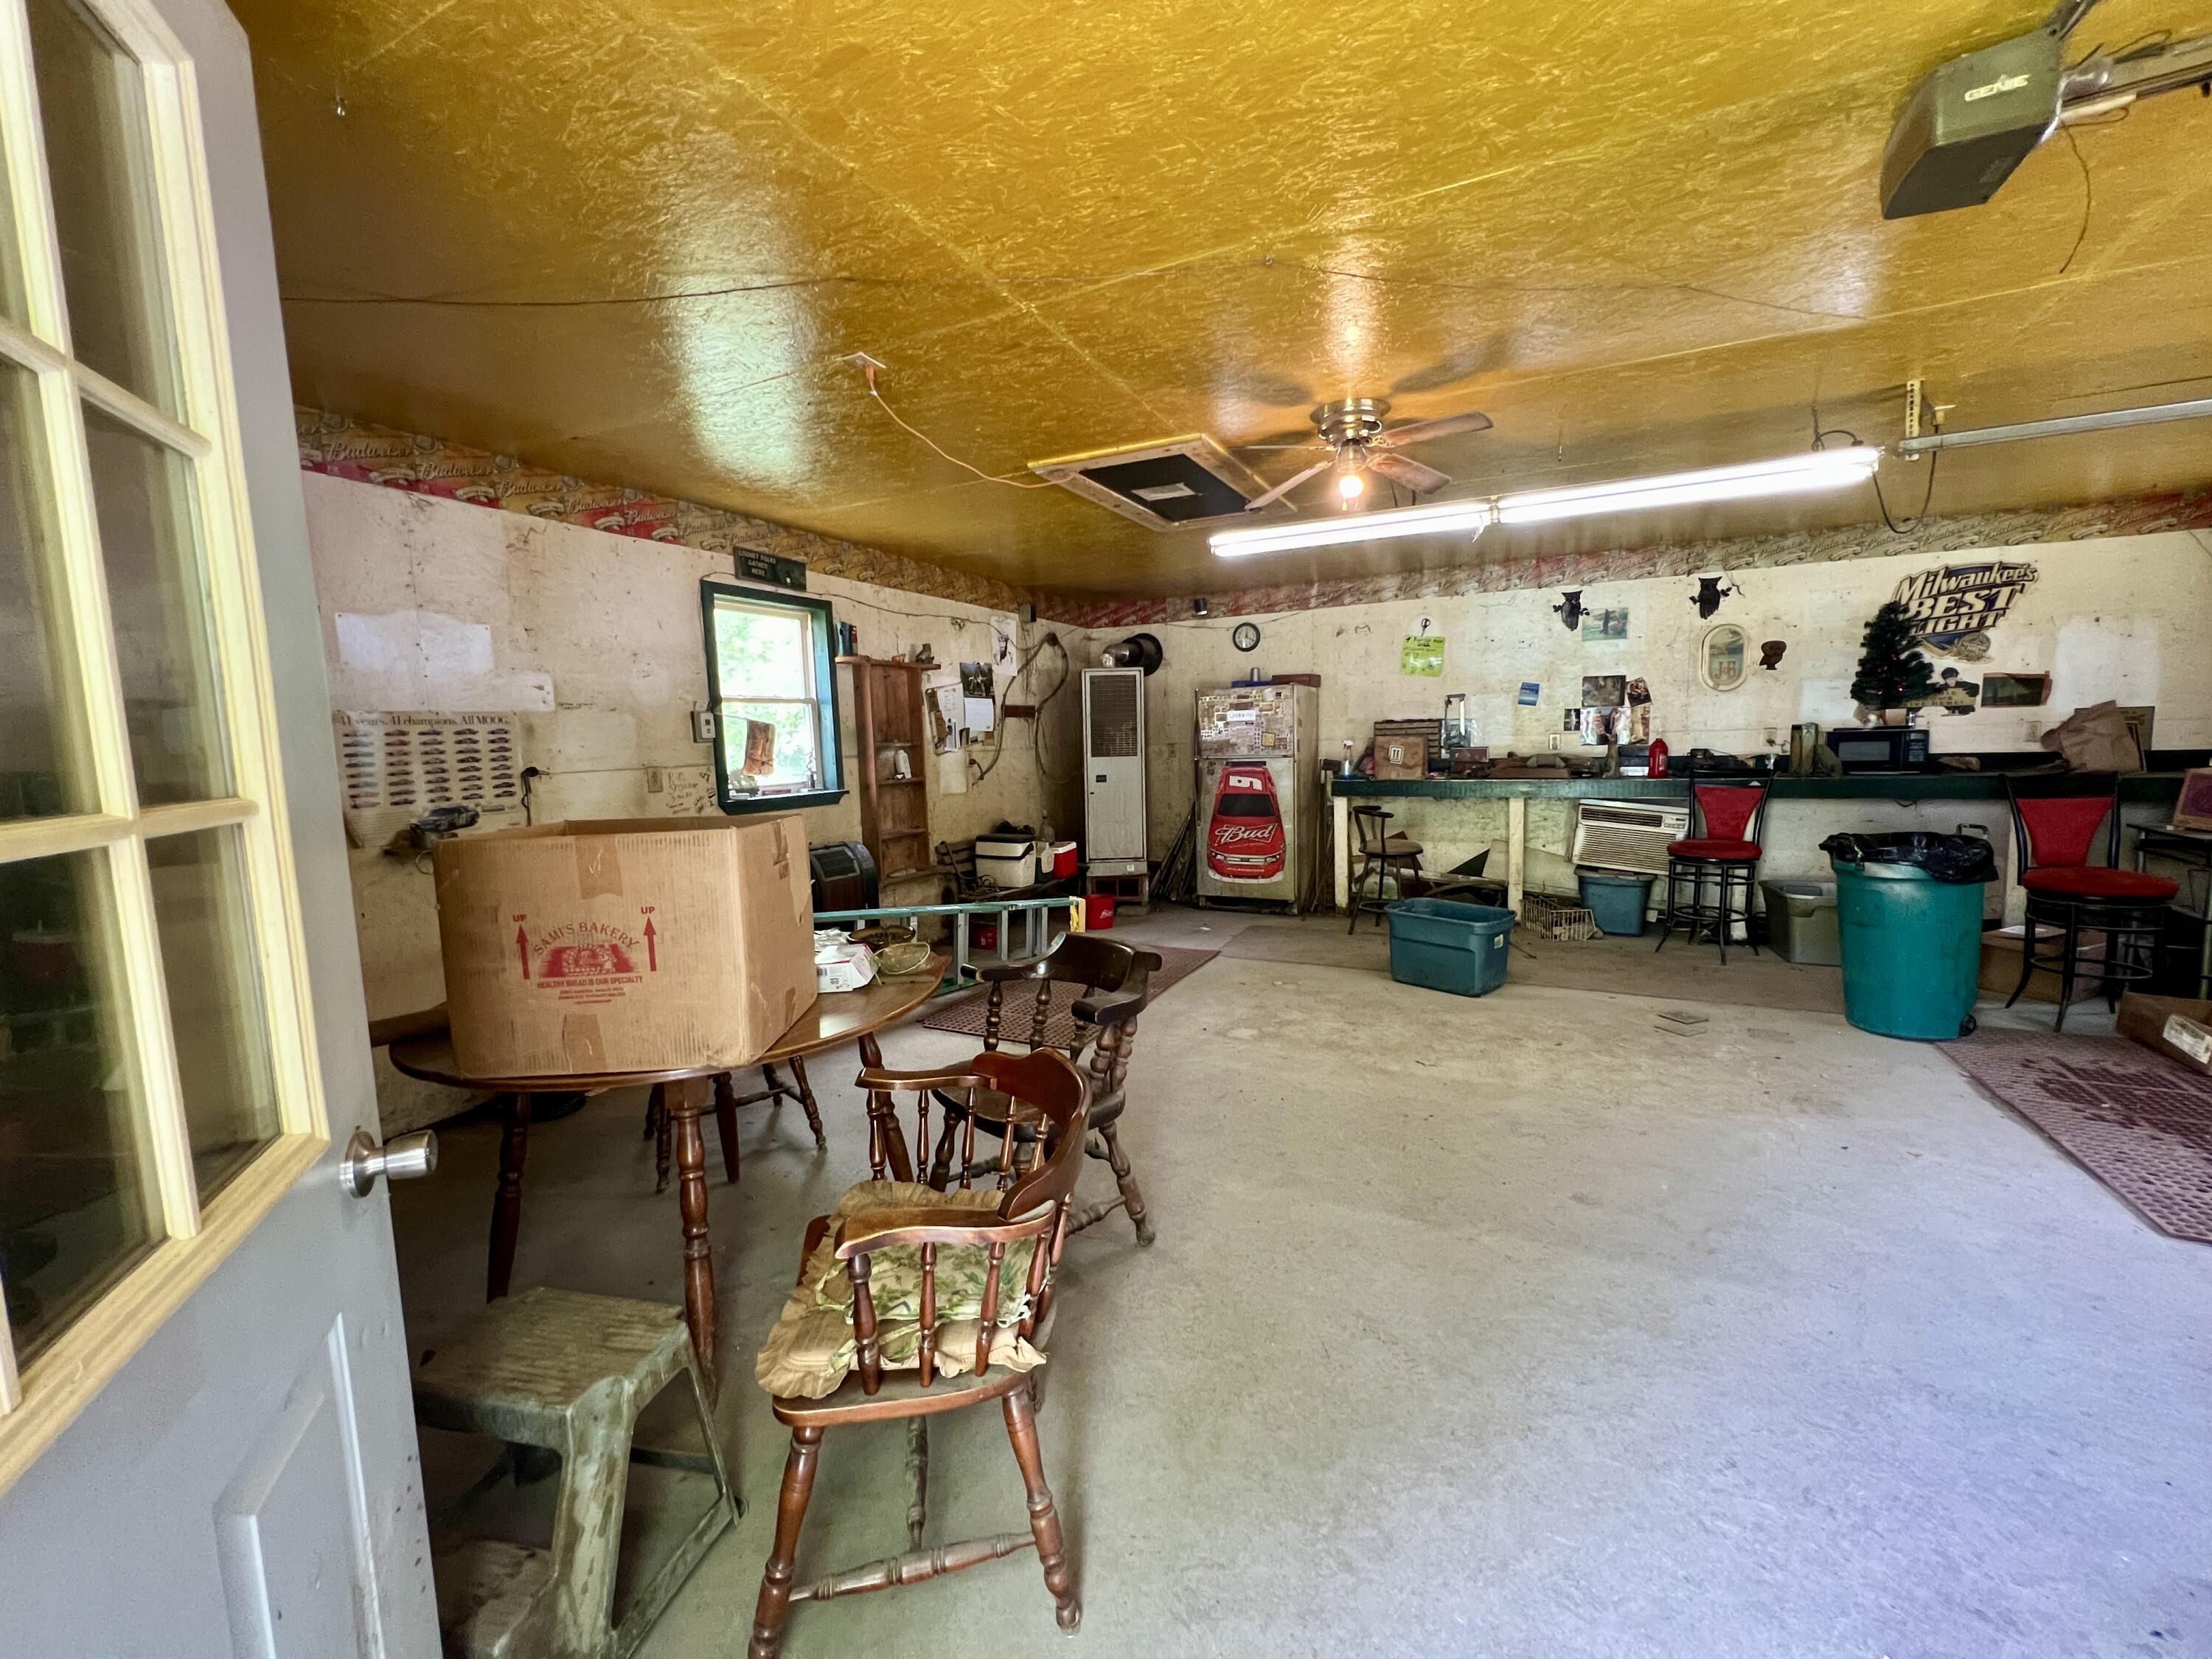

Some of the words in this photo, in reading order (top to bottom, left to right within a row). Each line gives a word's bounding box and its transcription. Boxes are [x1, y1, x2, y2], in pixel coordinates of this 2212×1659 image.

[324, 442, 414, 461] Budweiser
[415, 462, 493, 480] Budweiser
[496, 480, 563, 498] Budweiser
[1899, 562, 2037, 605] Milwaukee's
[1905, 583, 2025, 620] BEST
[403, 715, 457, 728] champions.
[461, 715, 475, 725] All
[476, 715, 510, 725] MOOG.
[1215, 826, 1274, 845] Bud
[641, 906, 655, 914] UP
[534, 923, 575, 956] SAMI'S
[579, 922, 640, 947] BAKERY
[538, 981, 565, 989] HEALTHY
[566, 979, 587, 987] BREAD
[610, 975, 643, 984] SPECIALTY
